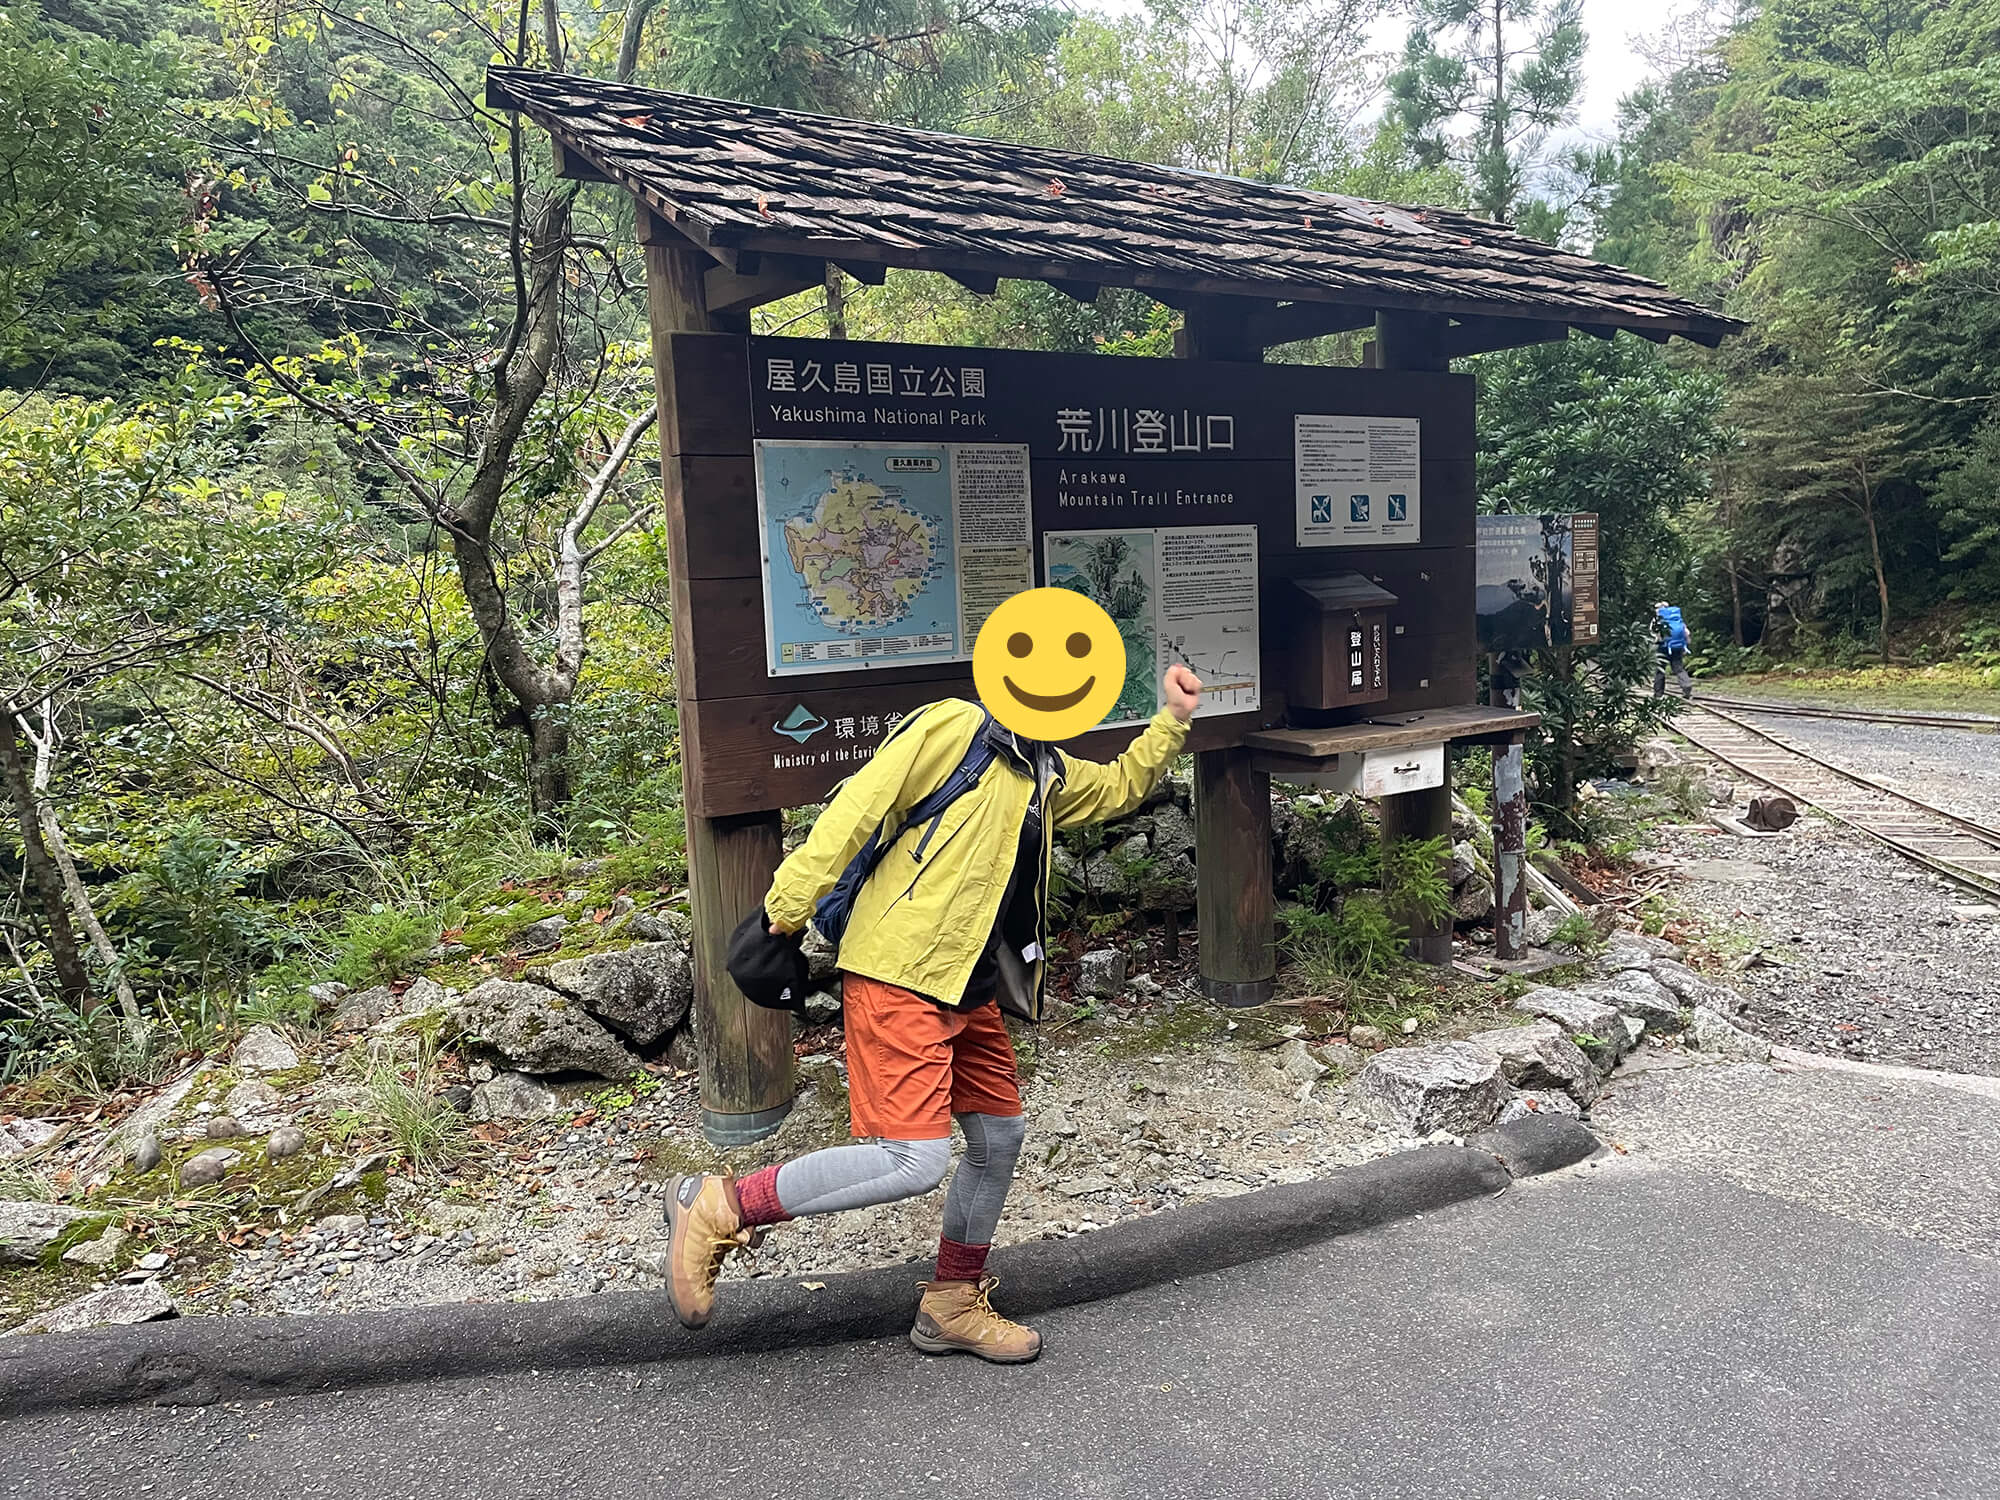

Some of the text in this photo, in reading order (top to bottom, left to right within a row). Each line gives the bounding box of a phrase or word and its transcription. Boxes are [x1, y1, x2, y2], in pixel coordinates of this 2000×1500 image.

[766, 358, 986, 399] 屋久島国立公園
[770, 404, 987, 427] Yakushima National Park
[1056, 407, 1235, 454] 荒川登山口
[1059, 468, 1127, 485] Arakawa
[1059, 489, 1235, 508] Mountain Trail Entrance
[1349, 630, 1363, 687] 登山届
[773, 751, 816, 769] Ministry
[820, 750, 831, 763] of
[835, 747, 850, 762] the
